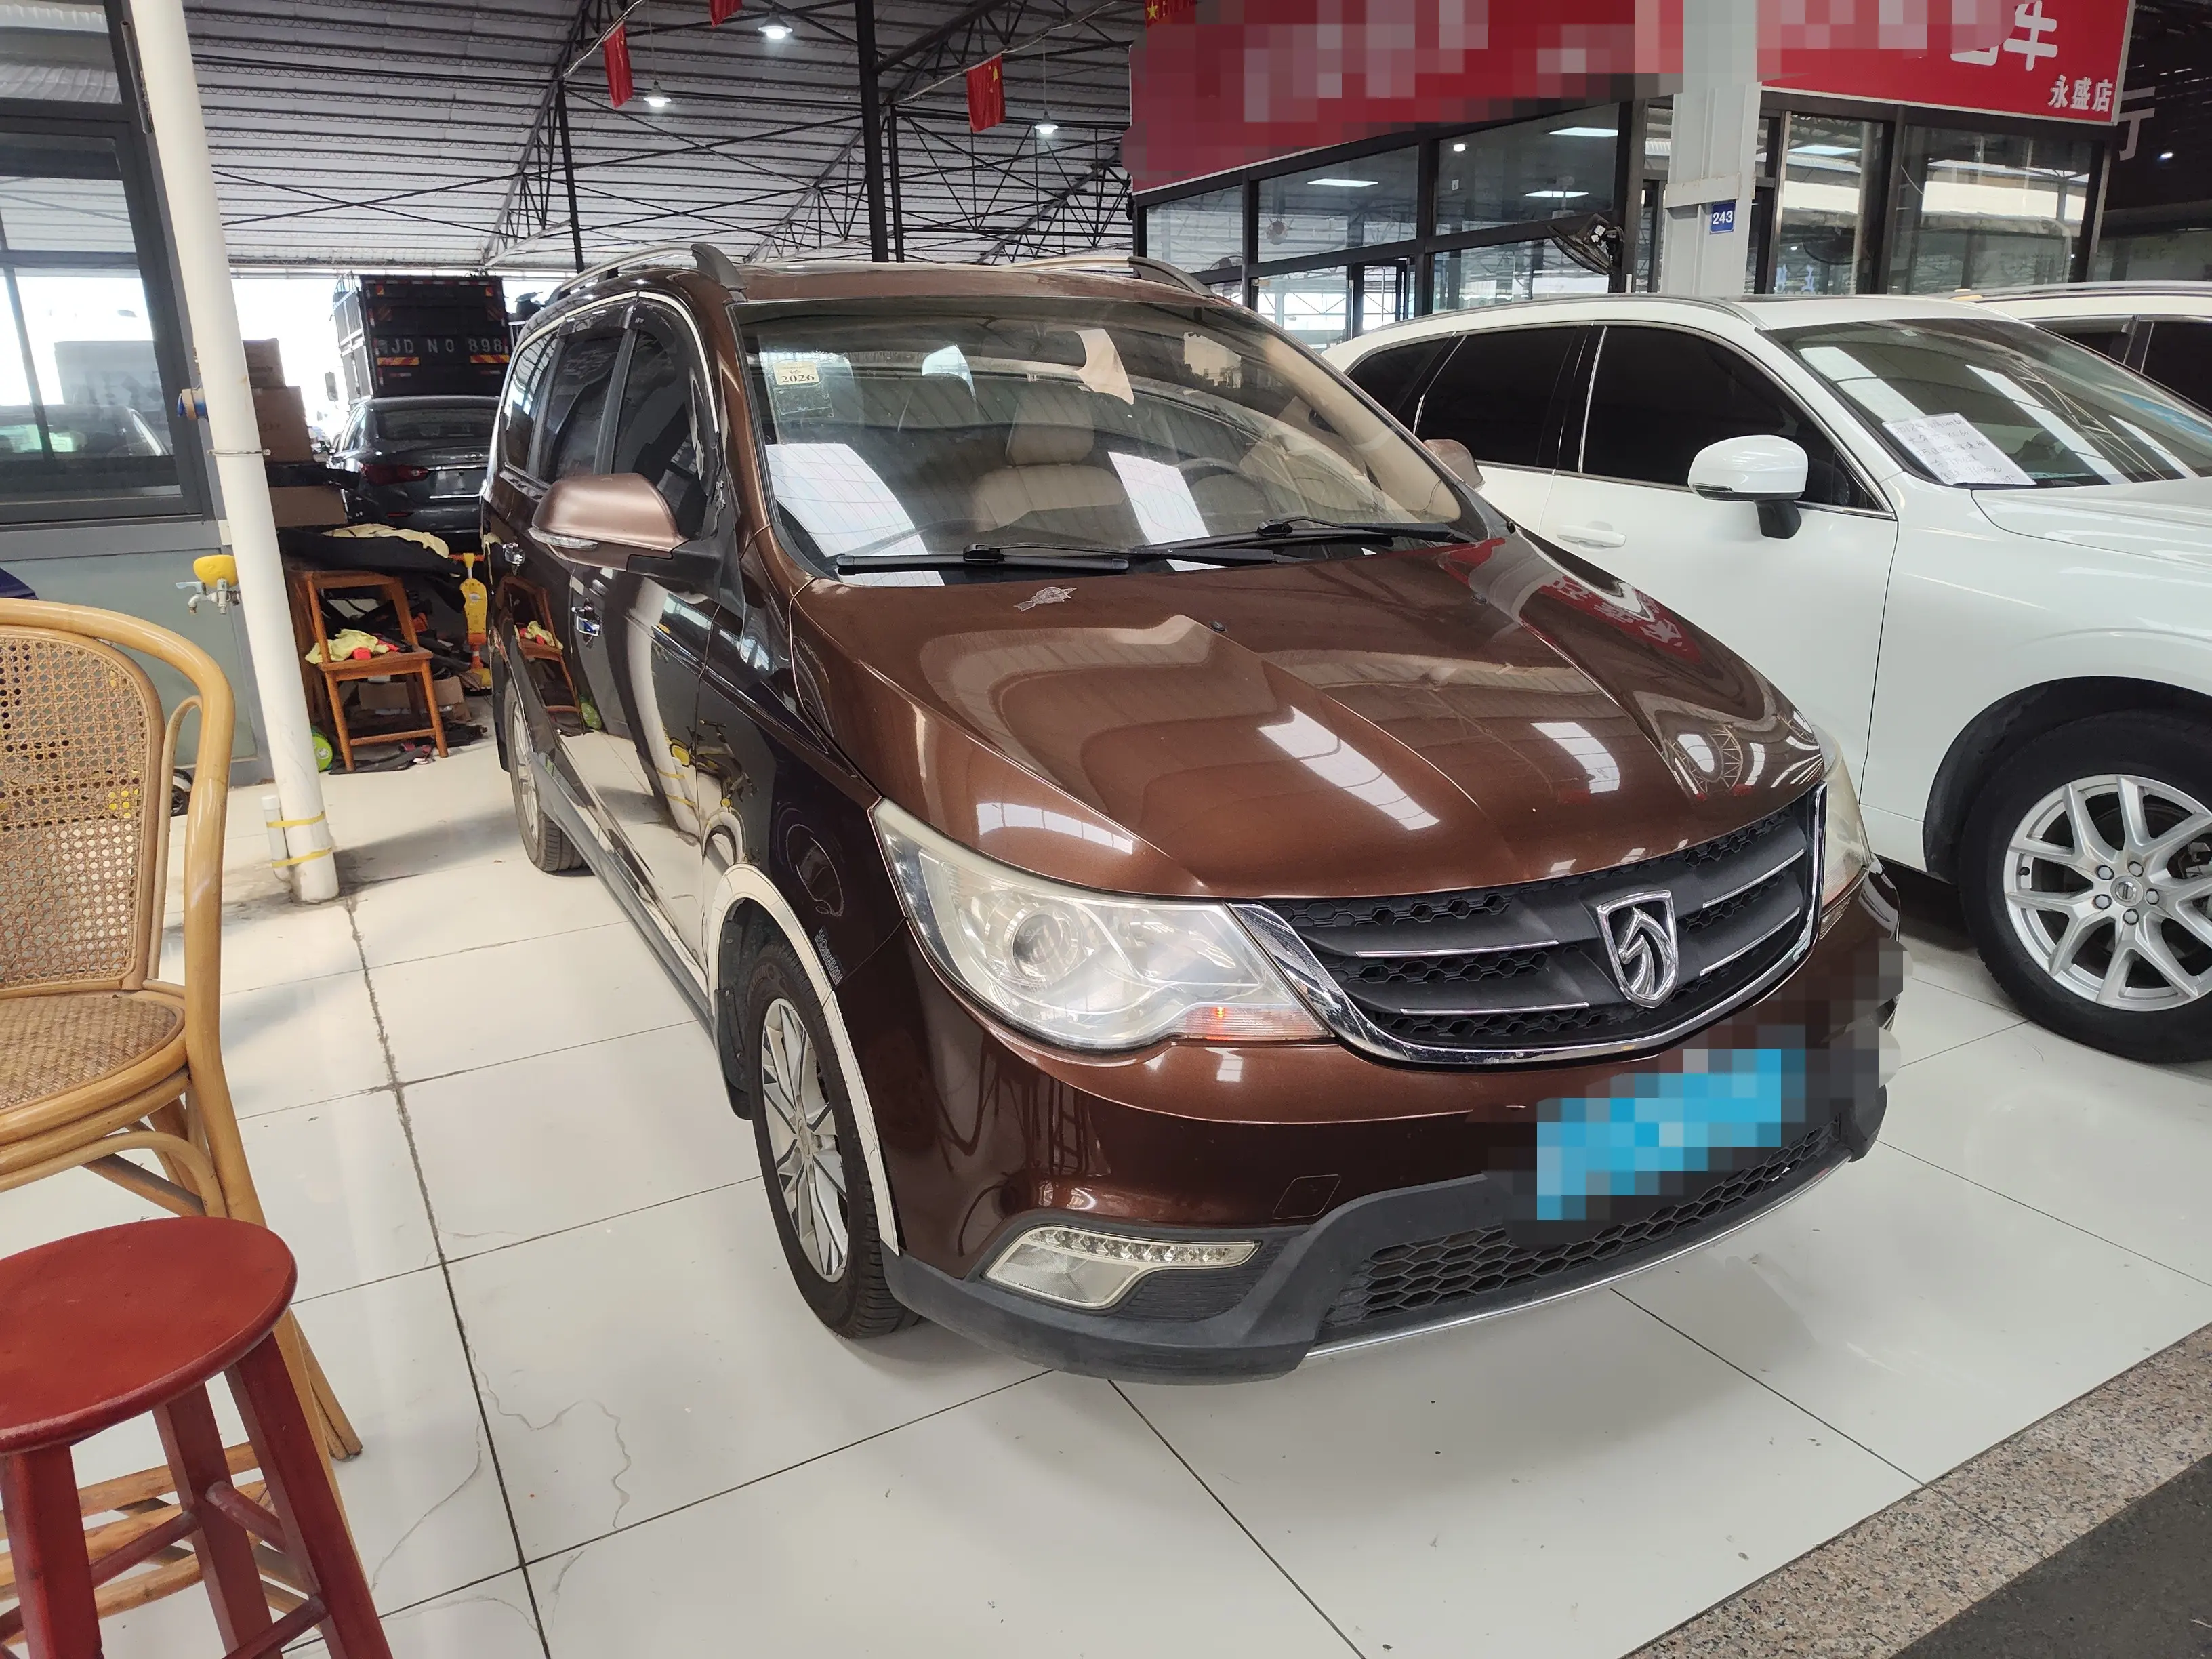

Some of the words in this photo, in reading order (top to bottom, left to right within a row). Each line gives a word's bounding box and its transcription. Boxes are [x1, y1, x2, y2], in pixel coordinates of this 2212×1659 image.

[2048, 74, 2114, 112] 永盛店
[1712, 210, 1734, 224] 243
[781, 374, 815, 383] 2026
